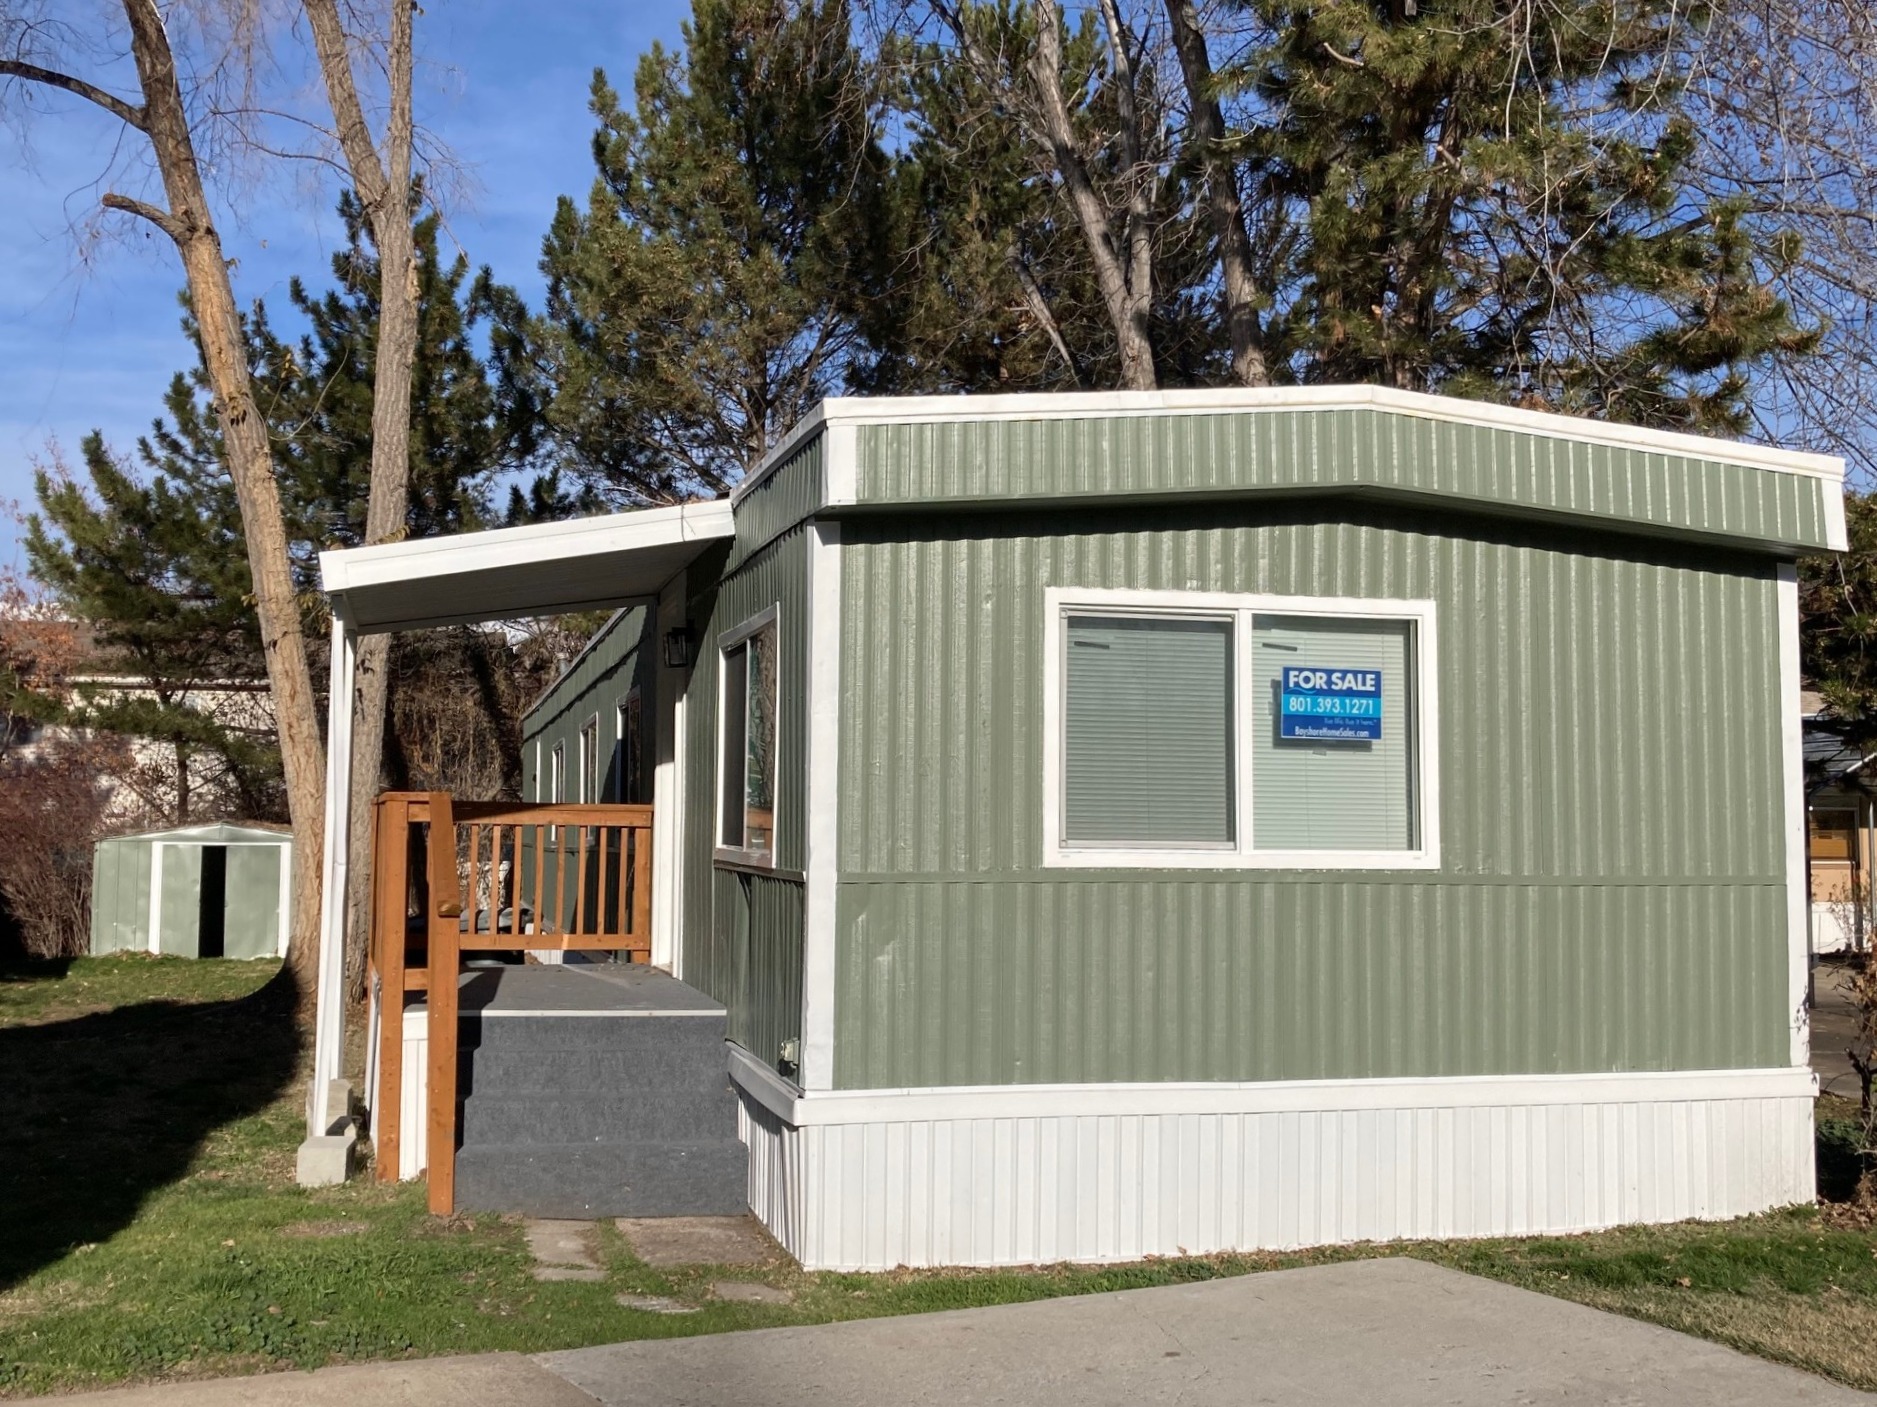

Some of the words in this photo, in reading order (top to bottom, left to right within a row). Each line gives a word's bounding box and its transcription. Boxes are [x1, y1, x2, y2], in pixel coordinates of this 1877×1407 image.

[1289, 671, 1328, 689] FOR
[1331, 672, 1375, 691] SALE
[1289, 697, 1373, 715] 801.393.1271
[1295, 726, 1369, 738] BayshoreHomeSales.com
